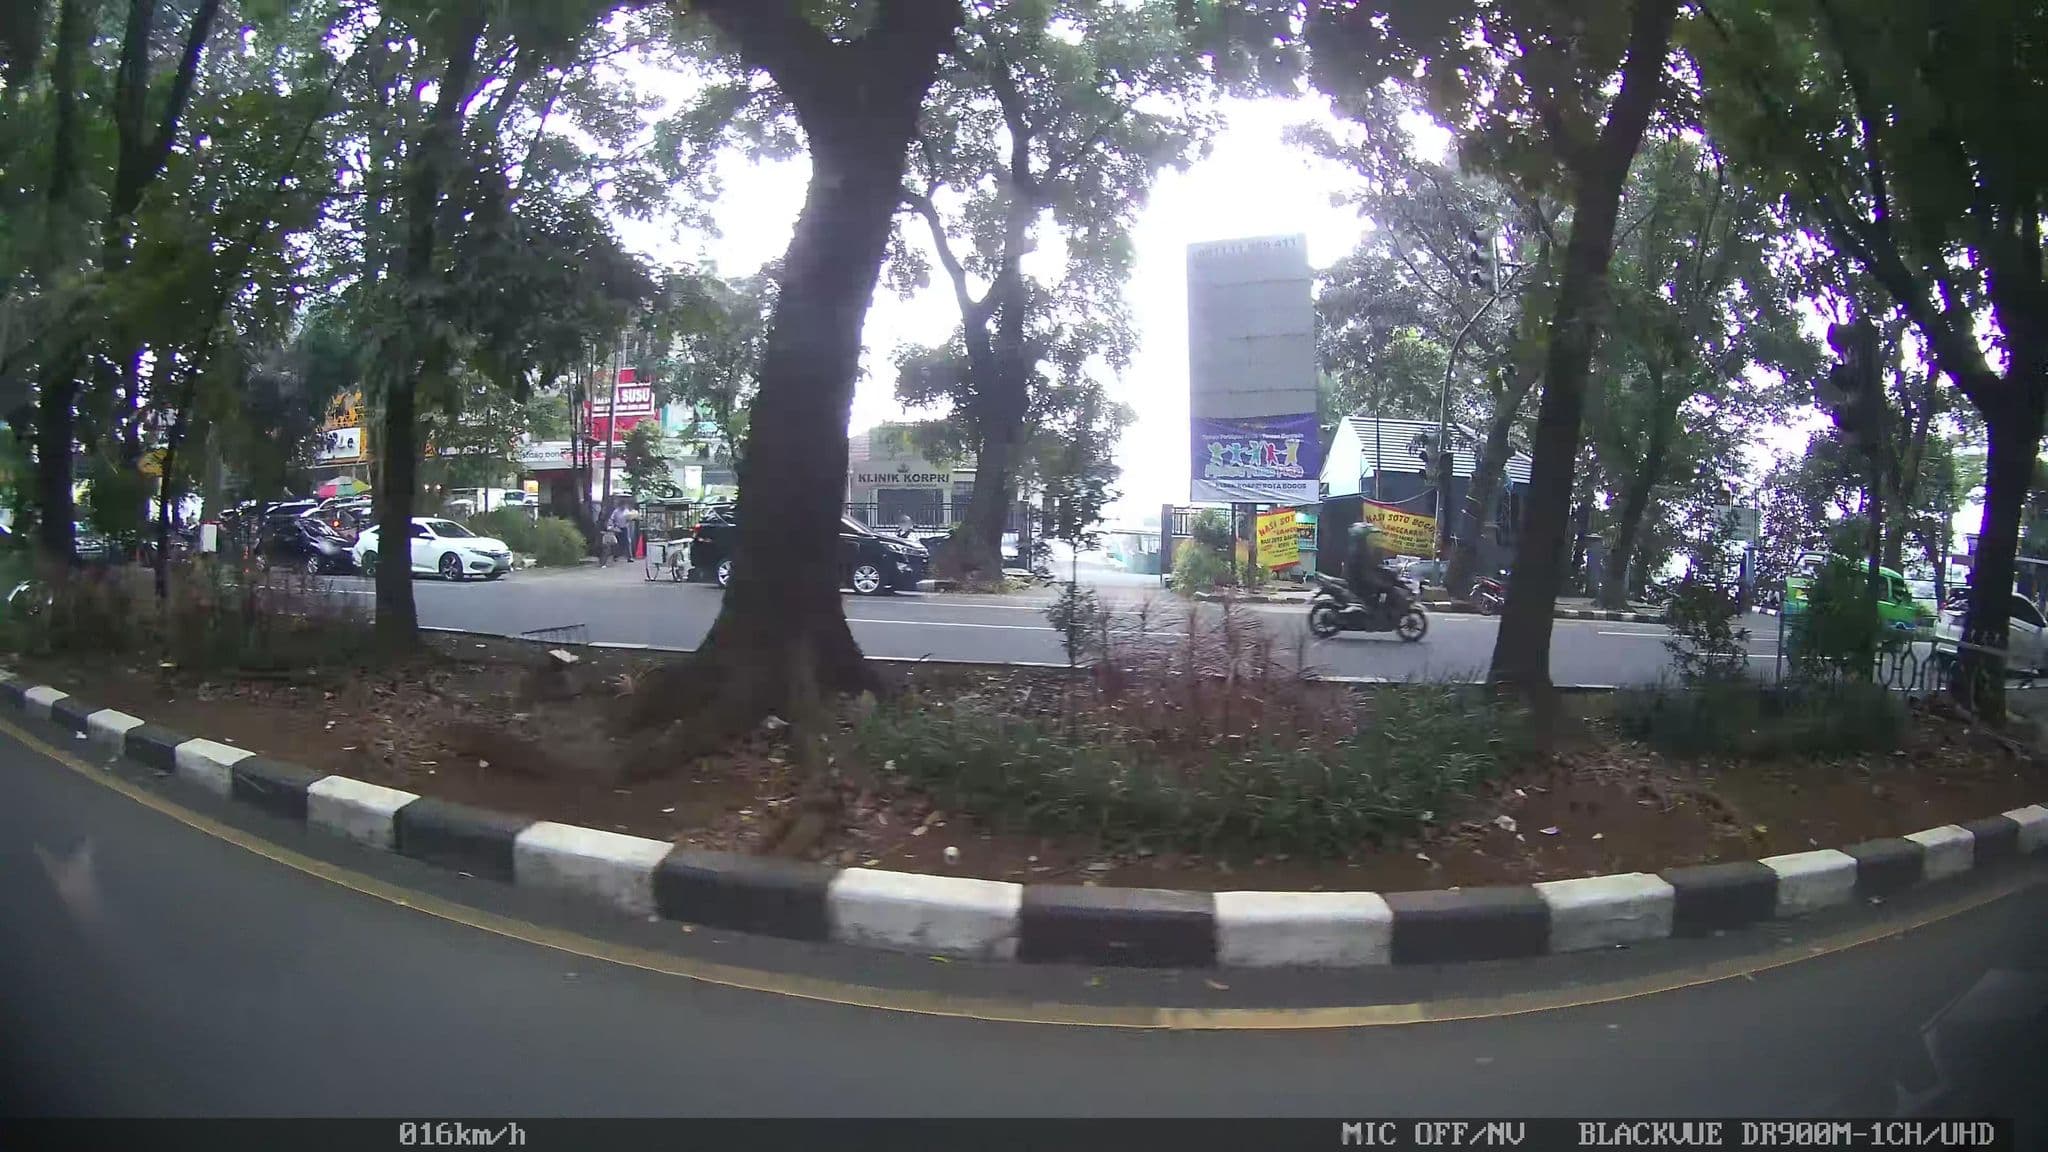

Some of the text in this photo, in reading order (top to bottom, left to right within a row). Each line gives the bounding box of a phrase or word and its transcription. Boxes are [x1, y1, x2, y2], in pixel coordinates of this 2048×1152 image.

[621, 388, 650, 403] SUSU
[858, 473, 950, 483] KLINIK KORPRI
[1388, 513, 1410, 524] SOTO
